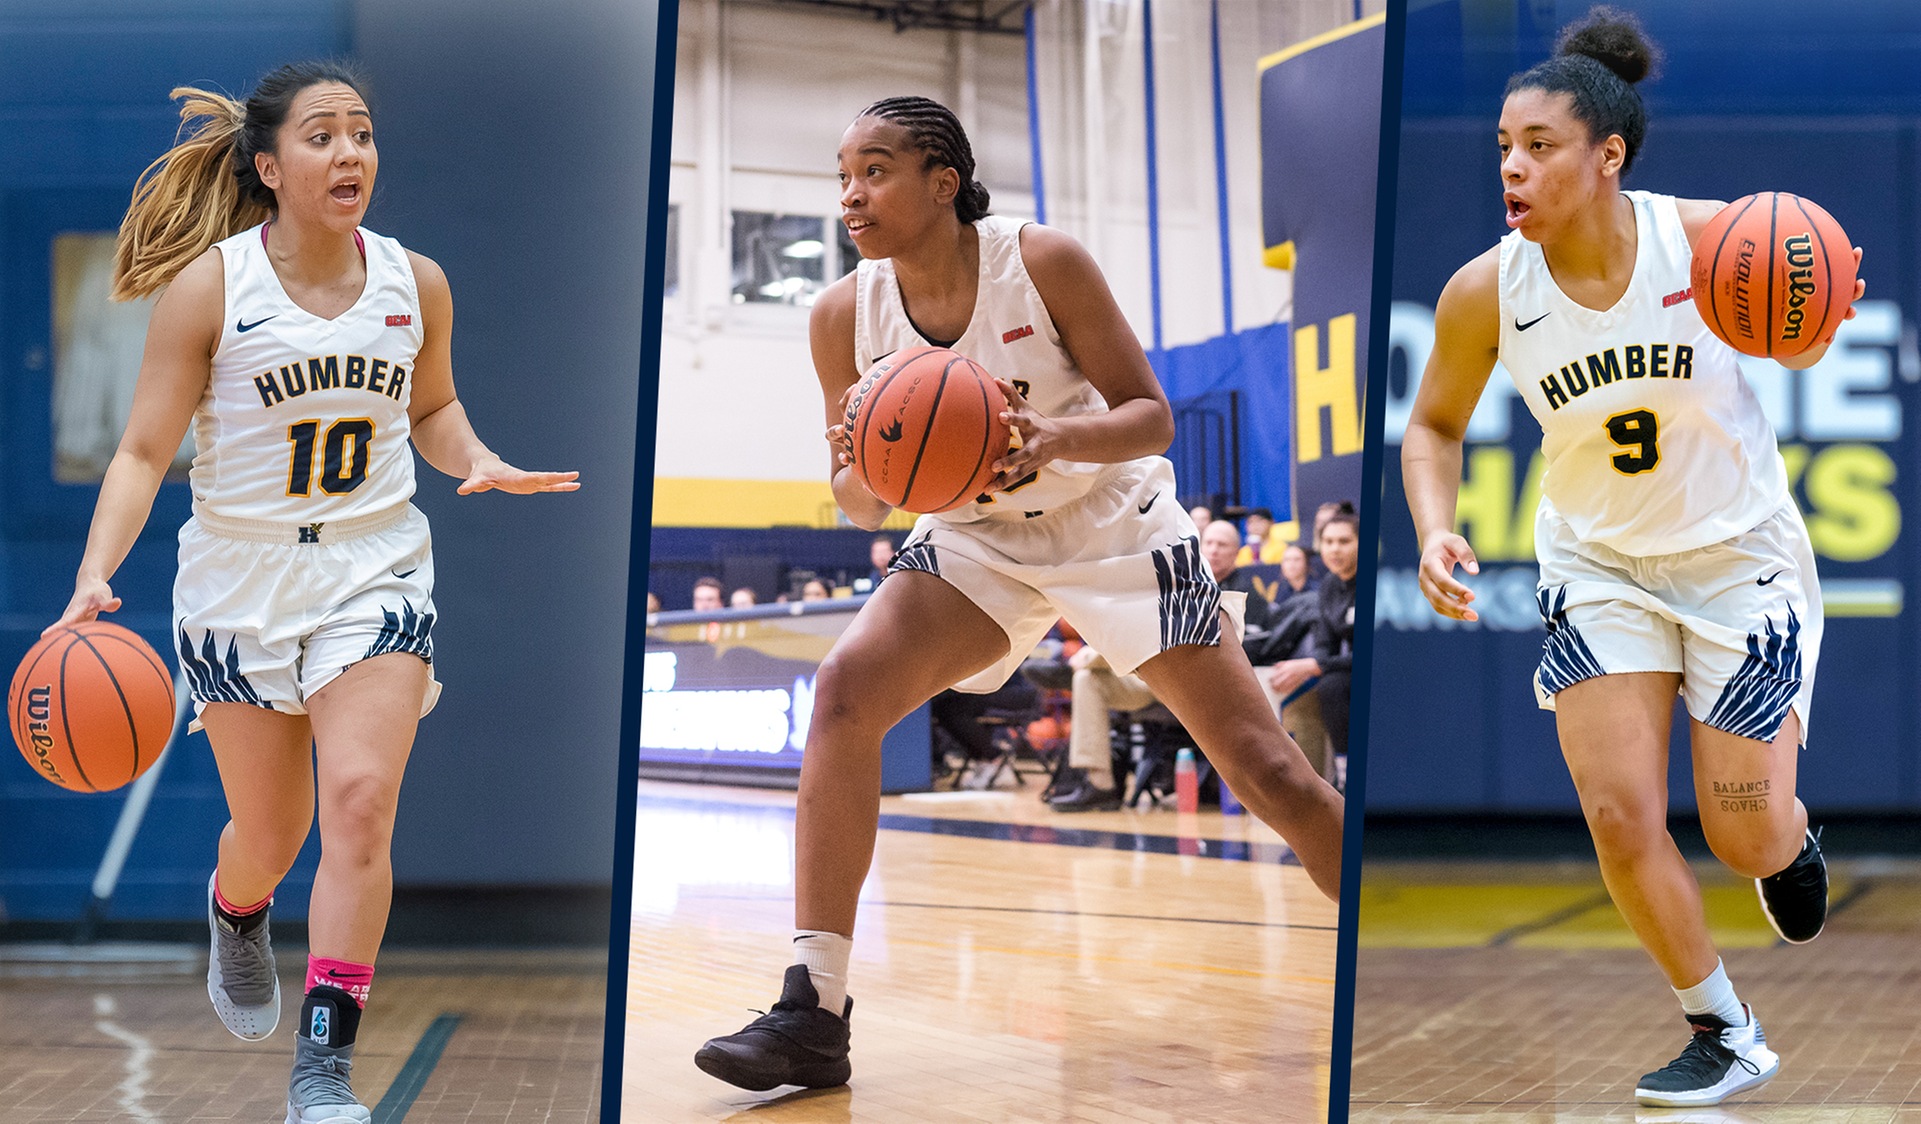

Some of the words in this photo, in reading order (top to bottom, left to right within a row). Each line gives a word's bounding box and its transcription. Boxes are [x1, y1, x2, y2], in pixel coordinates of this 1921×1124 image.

[1735, 238, 1756, 339] EVOLUTION
[1781, 231, 1817, 342] Wilson
[252, 353, 406, 408] HUMBER
[1294, 312, 1365, 464] H
[1539, 343, 1694, 411] HUMBER
[285, 416, 377, 498] 10
[881, 447, 892, 484] CCAA
[899, 376, 922, 416] ACSC
[1602, 406, 1662, 477] 9
[1712, 779, 1771, 793] BALANCE
